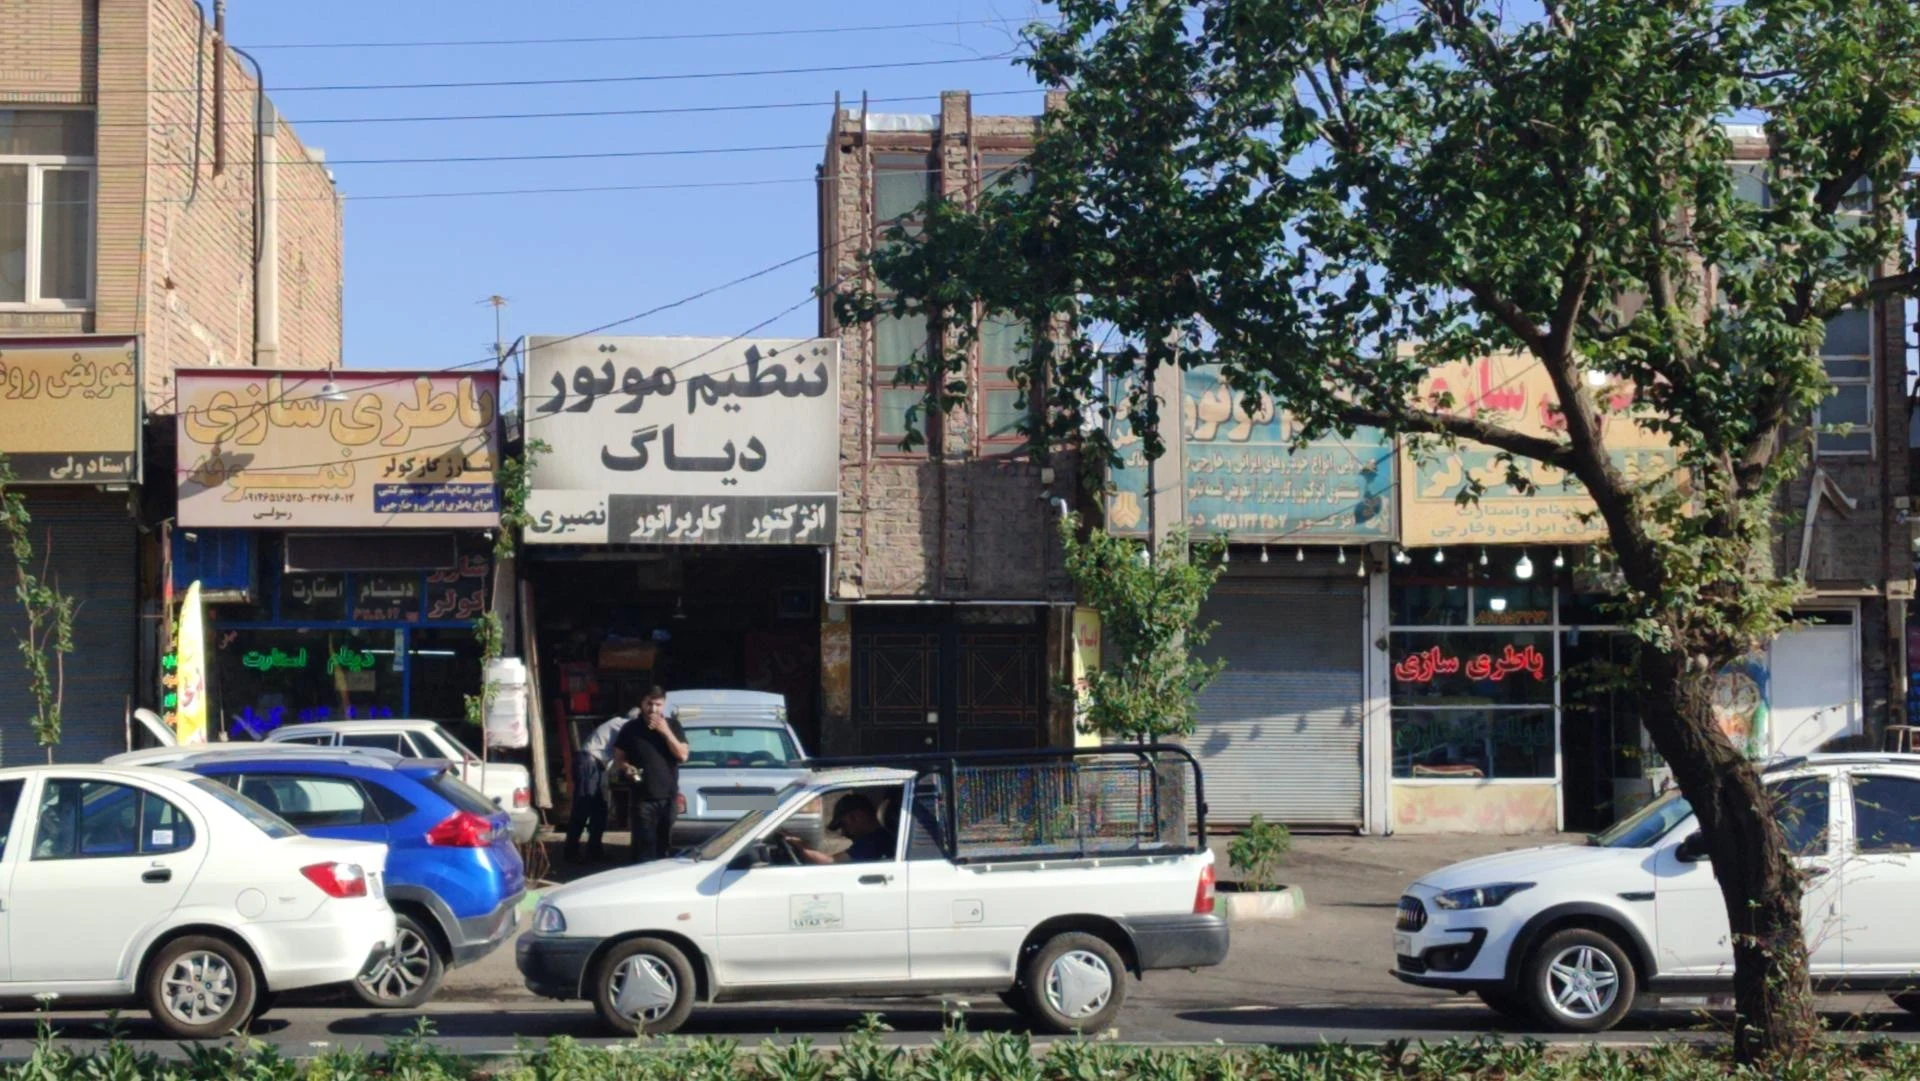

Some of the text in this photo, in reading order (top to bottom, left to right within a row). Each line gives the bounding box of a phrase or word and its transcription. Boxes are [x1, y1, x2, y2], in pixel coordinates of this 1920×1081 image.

[536, 344, 829, 414] تنظیم موتور
[184, 374, 327, 445] سازی
[50, 455, 132, 480] استاد ولی
[382, 456, 416, 478] کولر
[601, 424, 767, 485] دیاگ
[253, 506, 292, 520] رسولی
[530, 502, 826, 538] انژکتور کاربراتور نصیری
[291, 576, 415, 605] دینام استارت
[427, 588, 489, 618] کولر
[242, 646, 307, 671] استارت
[1395, 645, 1460, 681] سازی
